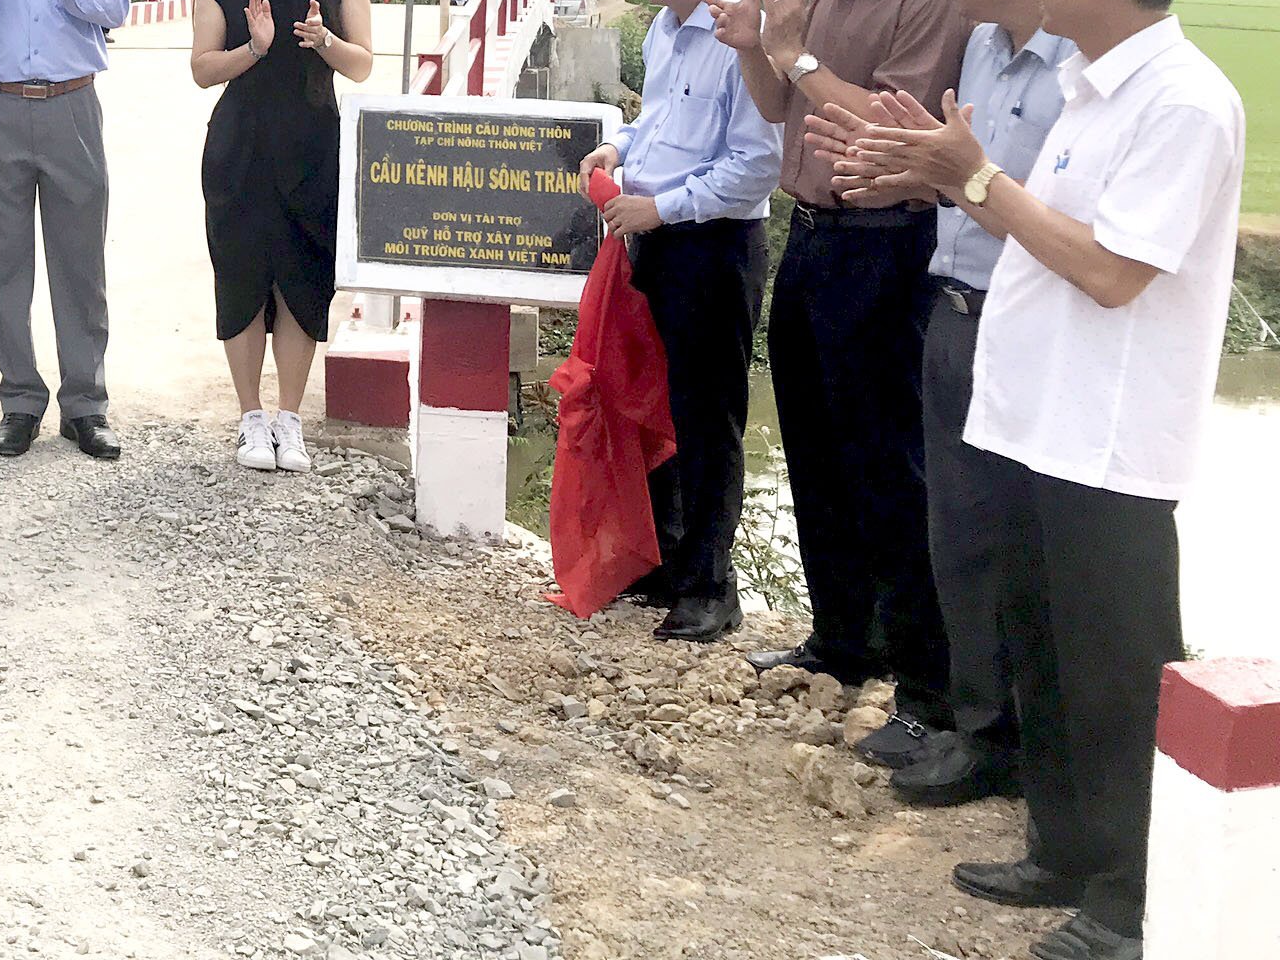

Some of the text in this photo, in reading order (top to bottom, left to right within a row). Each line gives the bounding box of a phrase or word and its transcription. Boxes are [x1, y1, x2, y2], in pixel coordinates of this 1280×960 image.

[386, 119, 433, 133] CHƯƠNG
[437, 120, 472, 134] TRÌNH
[503, 122, 535, 137] NÔNG
[538, 125, 571, 139] THÔN
[414, 135, 543, 153] TẠP CHÍ NÔNG THÔN VIỆT
[370, 153, 401, 184] CẦU
[405, 158, 447, 187] KÊNH
[453, 160, 484, 192] HẬU
[488, 162, 530, 192] SÔNG
[432, 211, 522, 227] ĐƠN VỊ TÀI TRỢ
[403, 225, 552, 248] QUỸ HỖ TRỢ XÂY DỰNG
[384, 240, 571, 265] MÔI TRƯỜNG XANH VIỆT NAM
